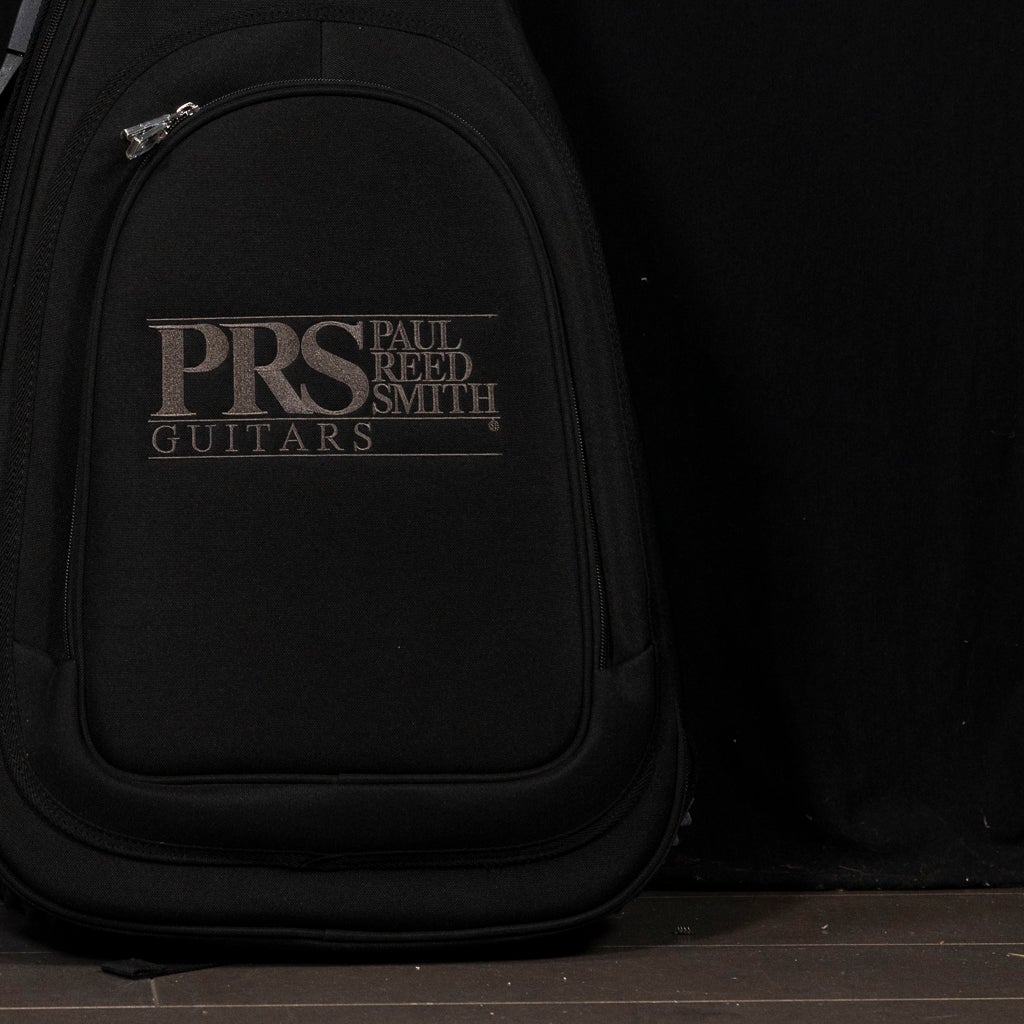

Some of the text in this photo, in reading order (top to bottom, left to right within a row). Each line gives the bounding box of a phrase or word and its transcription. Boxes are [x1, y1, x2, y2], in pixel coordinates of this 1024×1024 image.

[370, 319, 463, 351] PAUL
[148, 320, 370, 417] PRS
[371, 351, 473, 383] REED
[372, 383, 498, 416] SMITH
[151, 422, 373, 453] GUITARS
